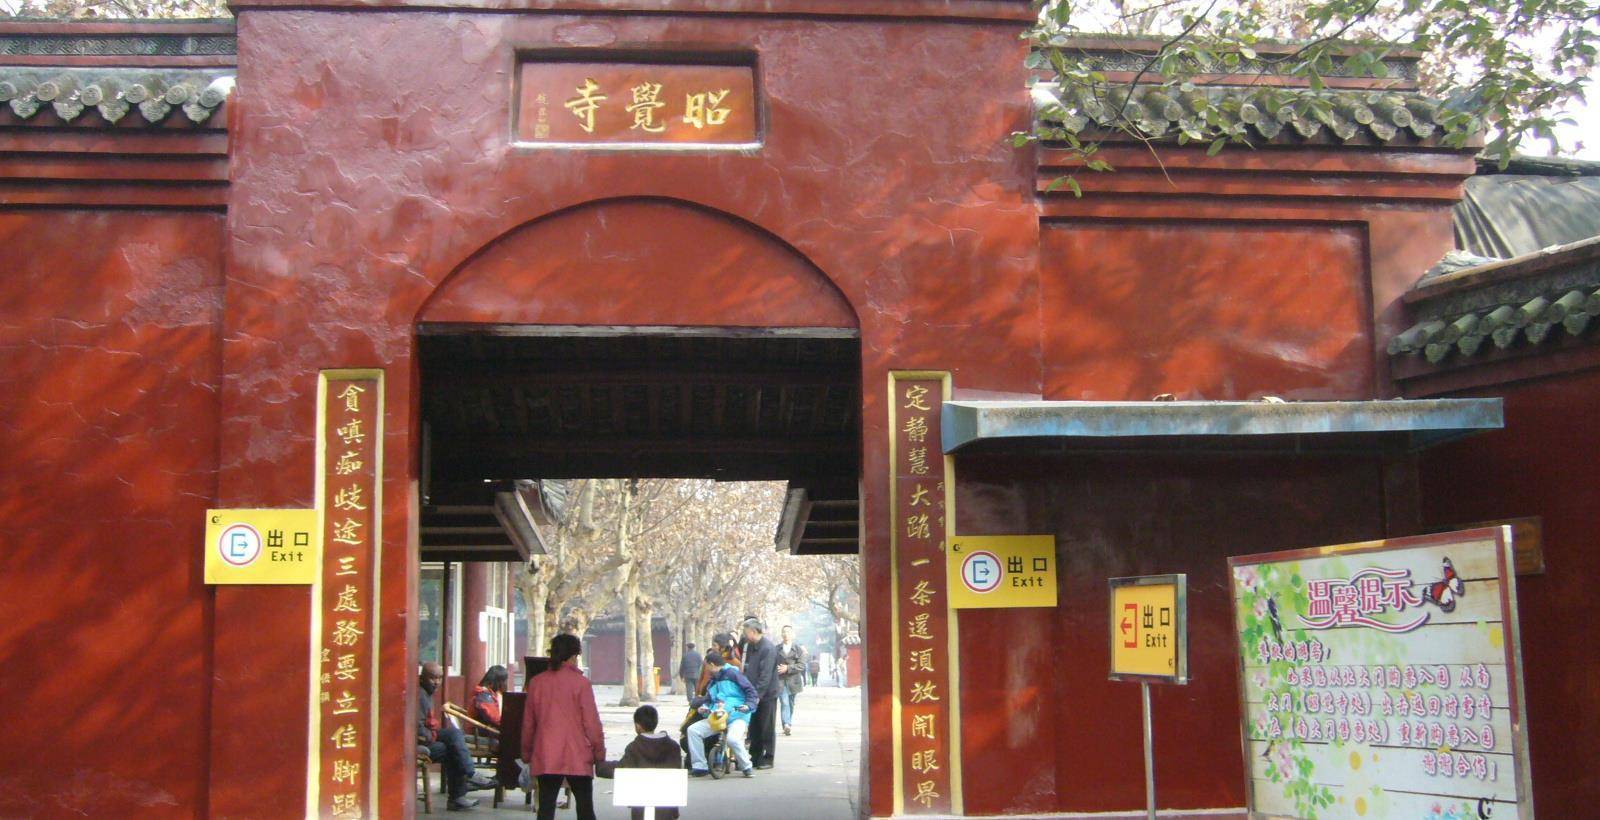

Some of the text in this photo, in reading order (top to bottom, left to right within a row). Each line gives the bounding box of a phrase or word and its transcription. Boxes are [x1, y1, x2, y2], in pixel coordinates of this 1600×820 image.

[267, 529, 309, 548] 出口
[271, 550, 304, 562] Exit
[1007, 556, 1048, 574] 出口
[1012, 576, 1043, 588] Exit
[1308, 577, 1422, 625] 温馨提示
[1143, 604, 1170, 629] 出口
[1145, 633, 1167, 648] Exit
